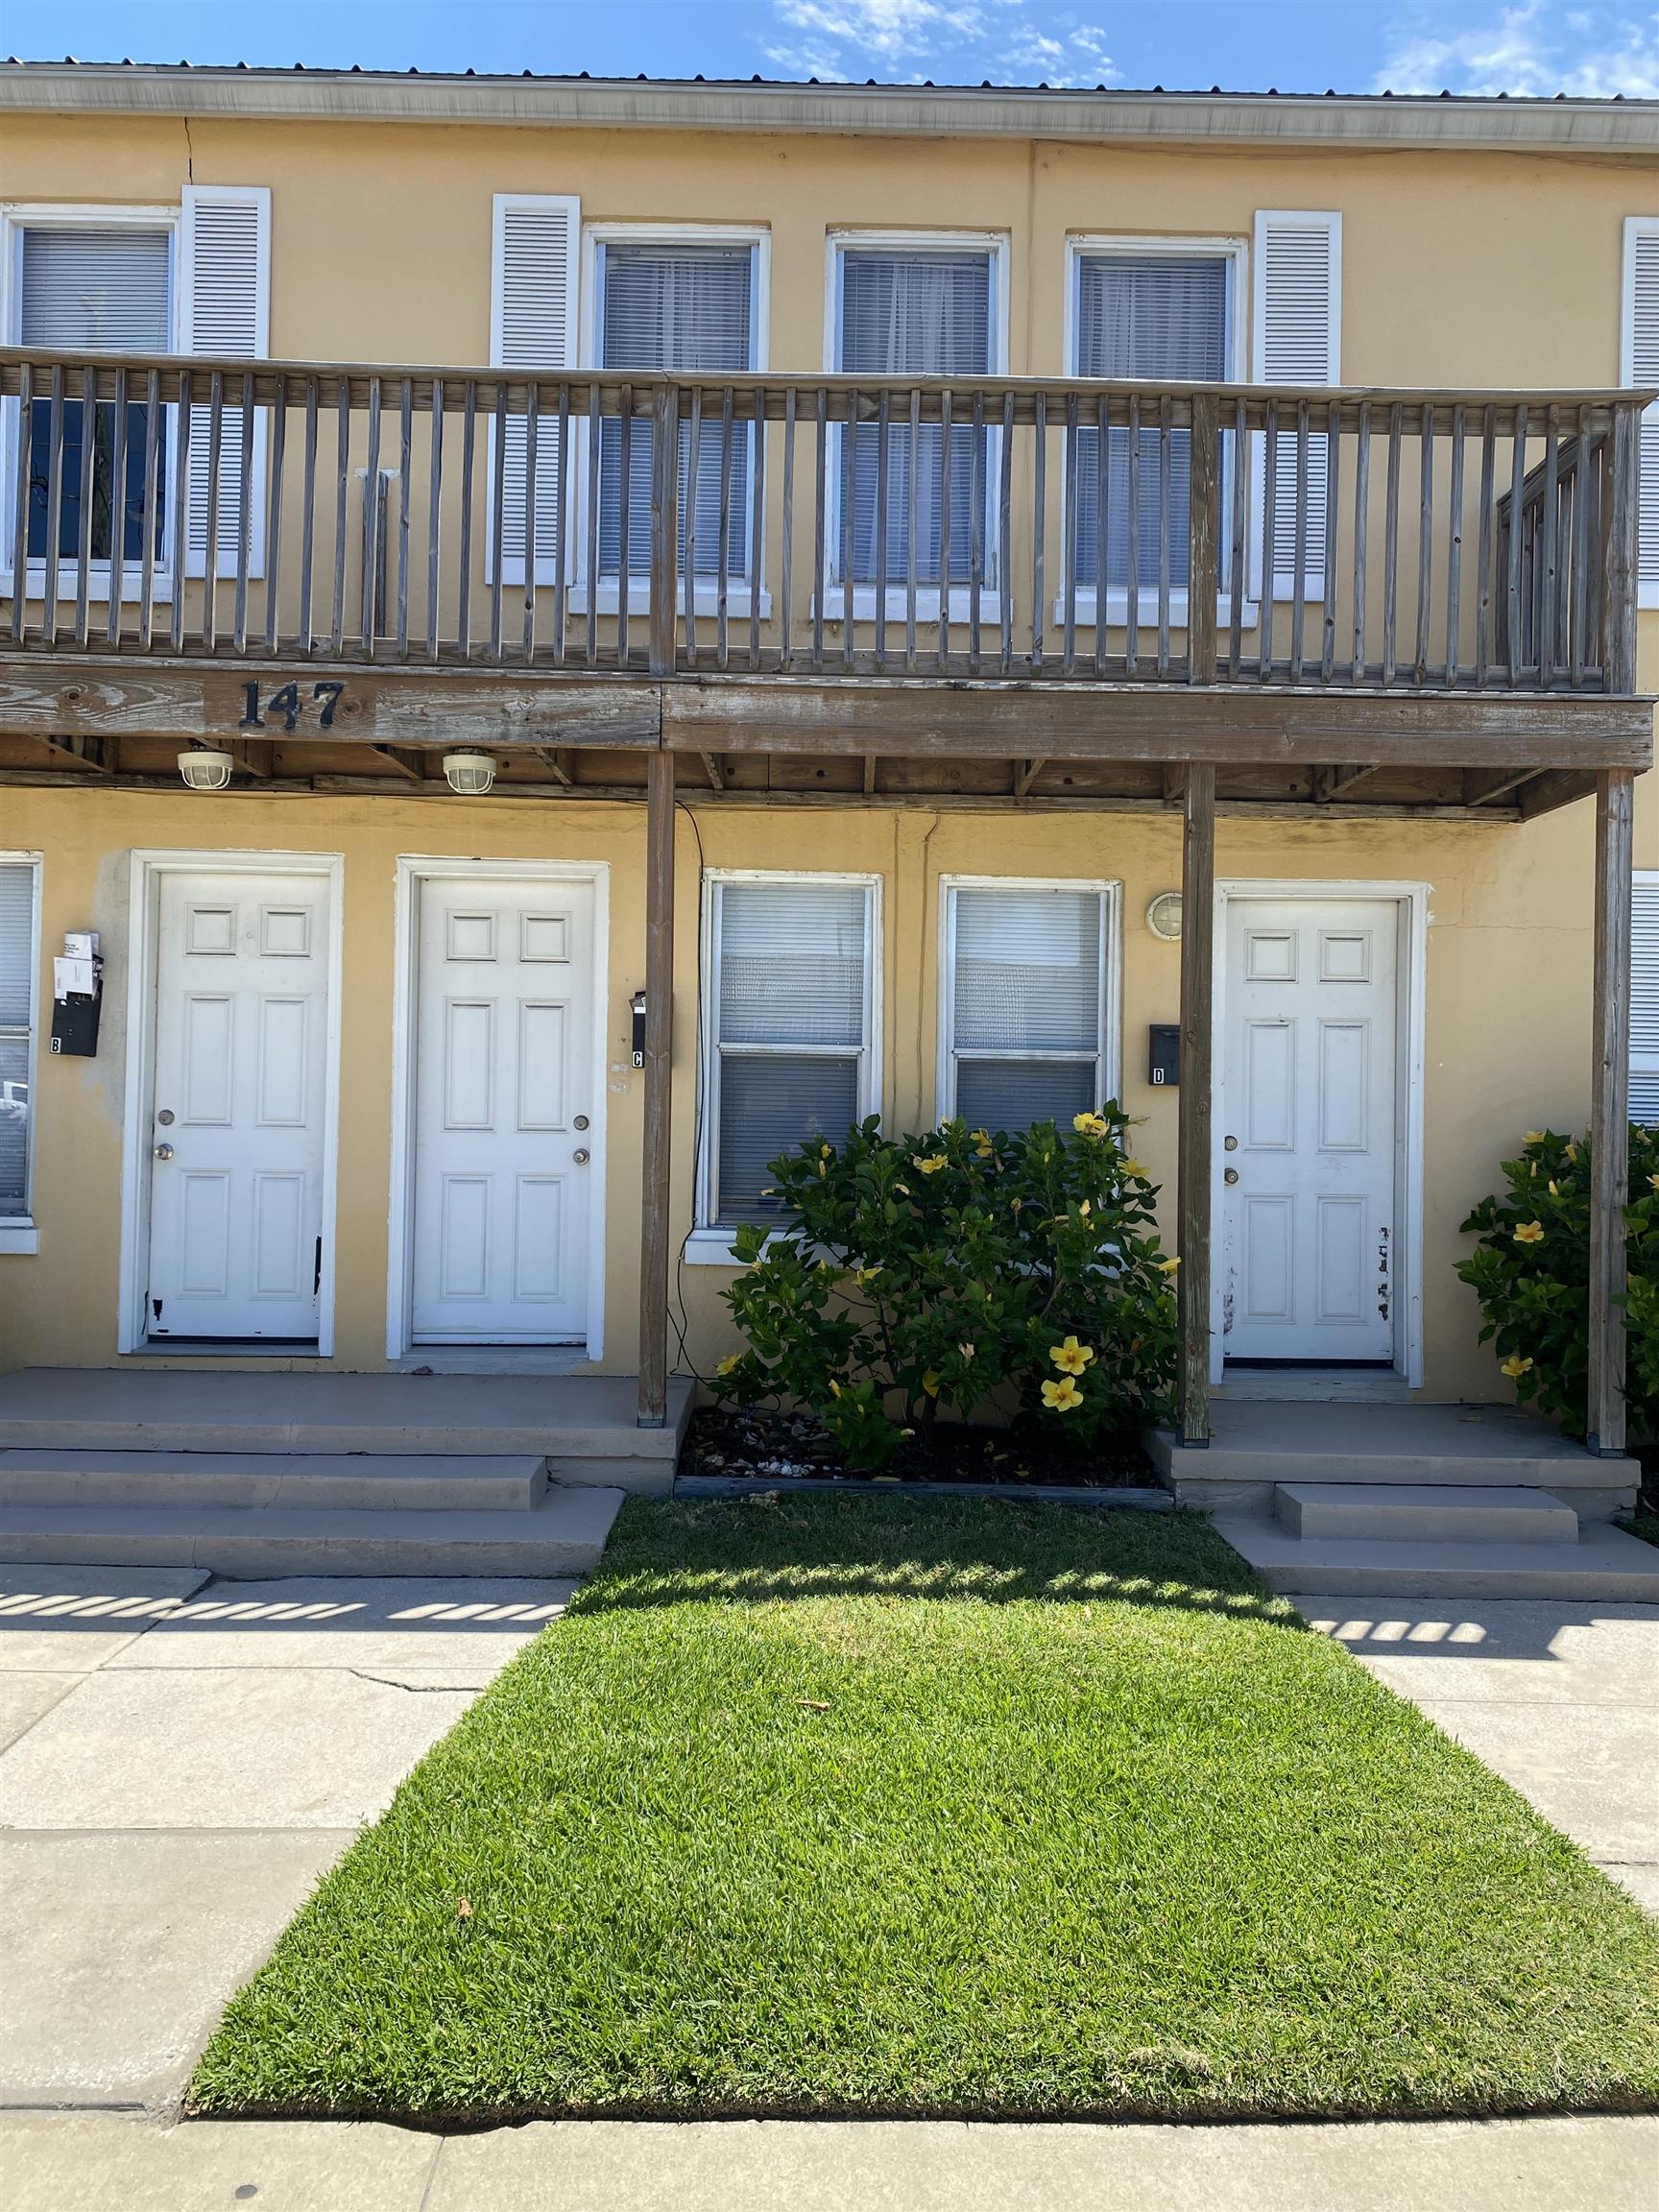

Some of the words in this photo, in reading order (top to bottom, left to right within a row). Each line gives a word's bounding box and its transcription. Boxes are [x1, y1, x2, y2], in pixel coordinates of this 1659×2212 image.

[239, 678, 345, 730] 147
[52, 1038, 60, 1052] B
[634, 1052, 641, 1067] C
[1155, 1069, 1163, 1083] D
